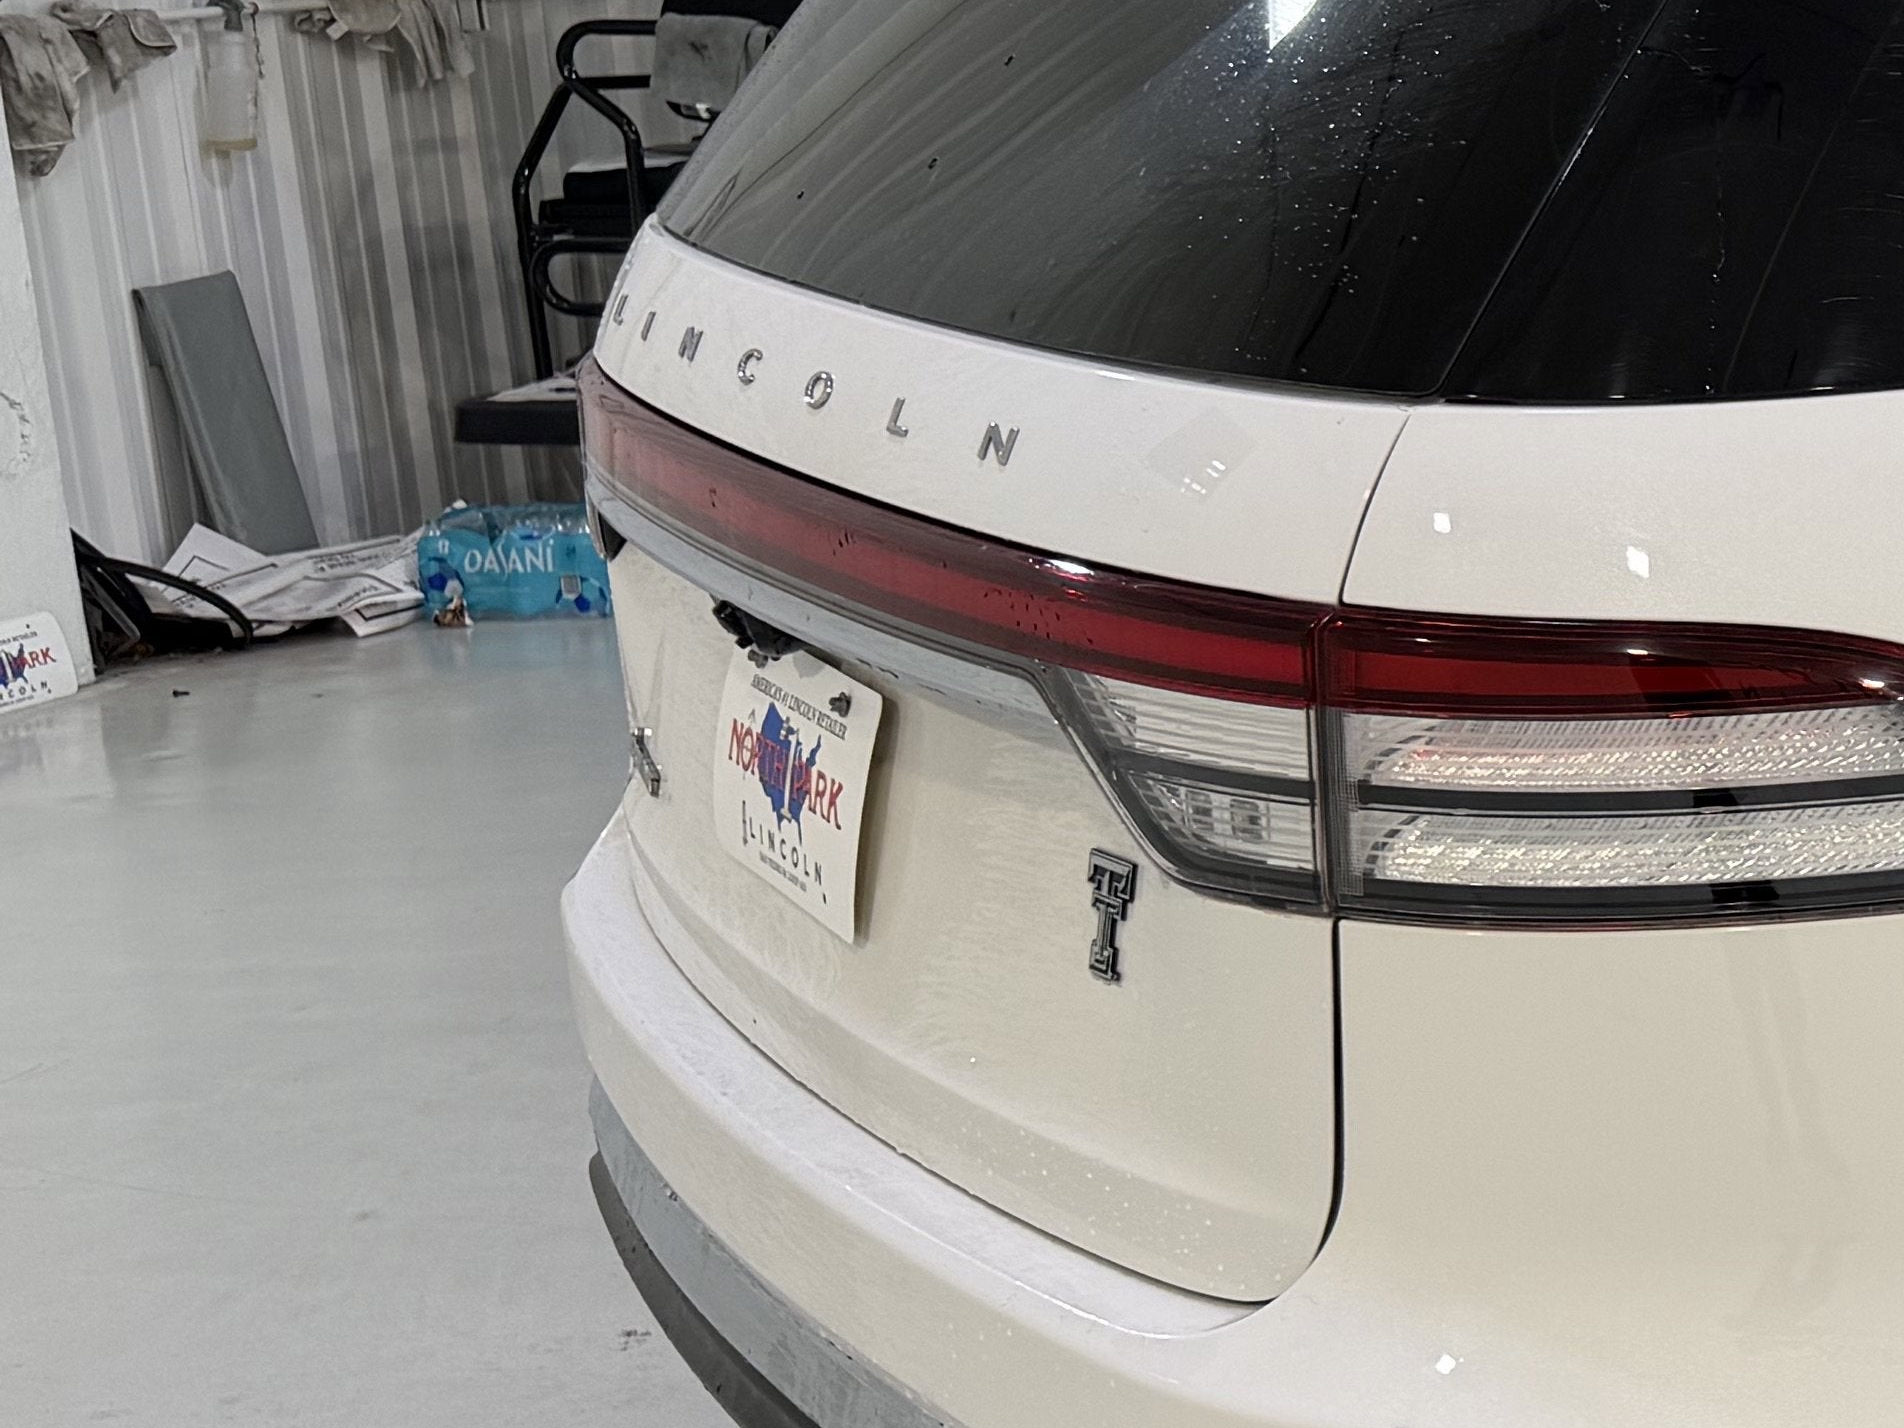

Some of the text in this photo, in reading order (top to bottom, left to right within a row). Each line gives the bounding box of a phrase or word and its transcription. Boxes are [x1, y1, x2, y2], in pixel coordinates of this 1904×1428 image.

[612, 293, 1020, 467] LINCOLN
[728, 718, 844, 830] NORTH PARK
[749, 816, 822, 887] LINCOLN
